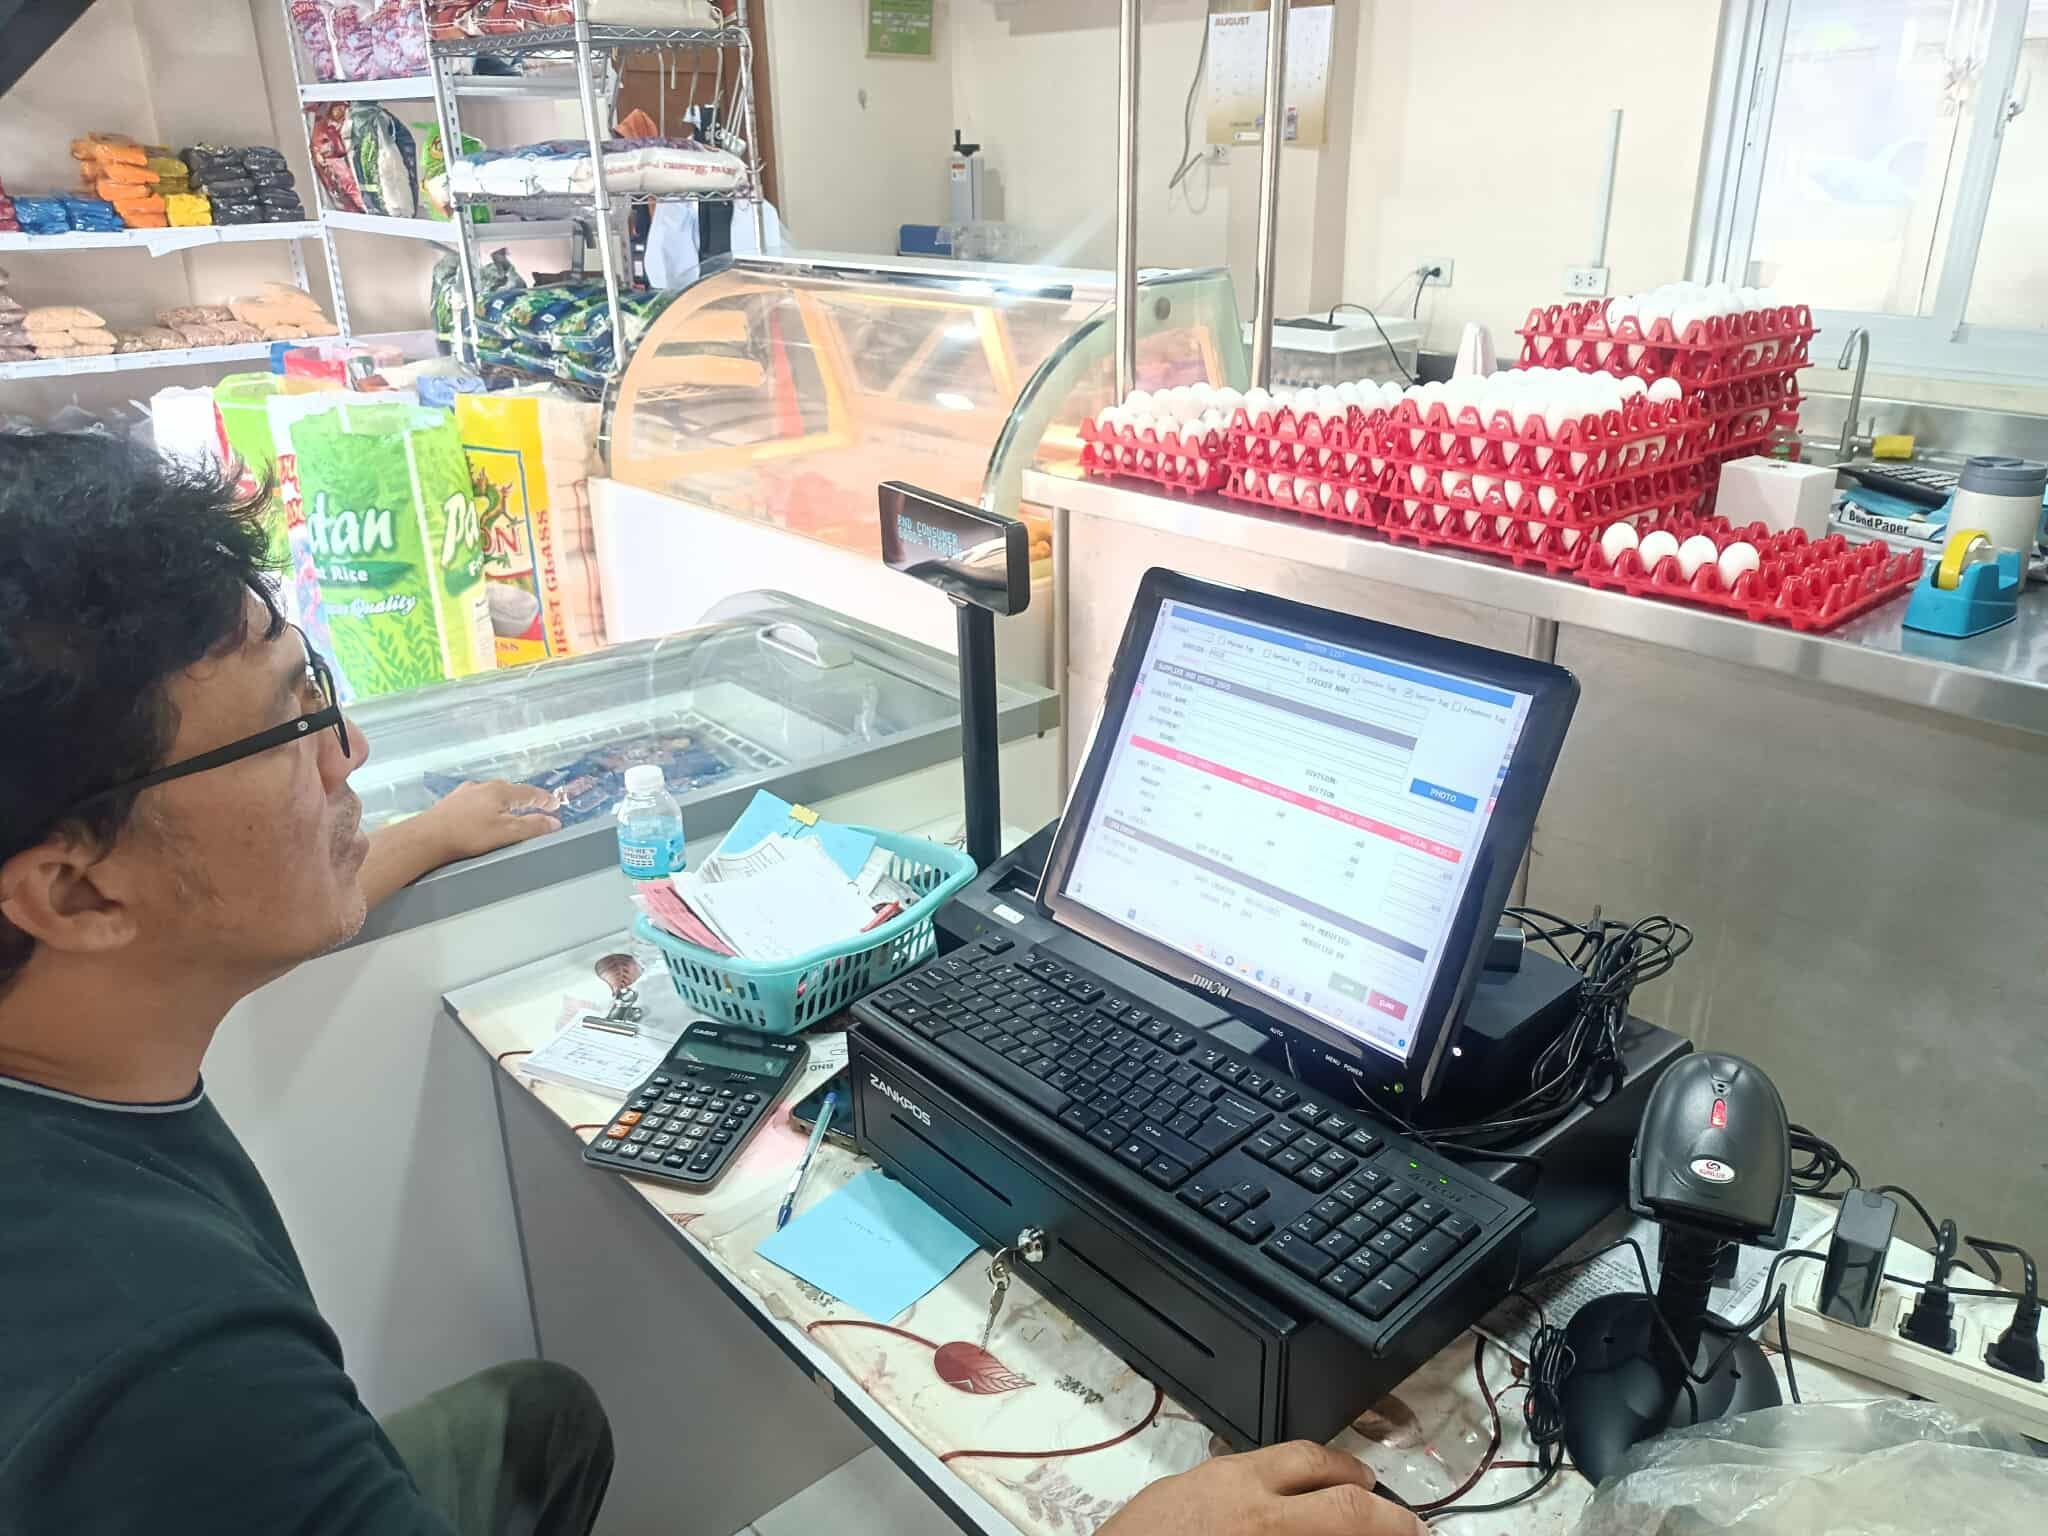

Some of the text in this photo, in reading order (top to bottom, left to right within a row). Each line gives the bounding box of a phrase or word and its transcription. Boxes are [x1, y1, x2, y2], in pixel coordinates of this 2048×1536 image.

[1215, 16, 1249, 26] AUGUST
[1875, 518, 1908, 534] Paper
[536, 510, 558, 592] CLASS
[331, 567, 368, 582] Rice
[351, 595, 416, 618] Quality
[1430, 787, 1457, 803] PHOTO
[1191, 973, 1232, 999] ORION
[1325, 1054, 1363, 1078] MENU POWER
[869, 1072, 931, 1127] ZANKPOS
